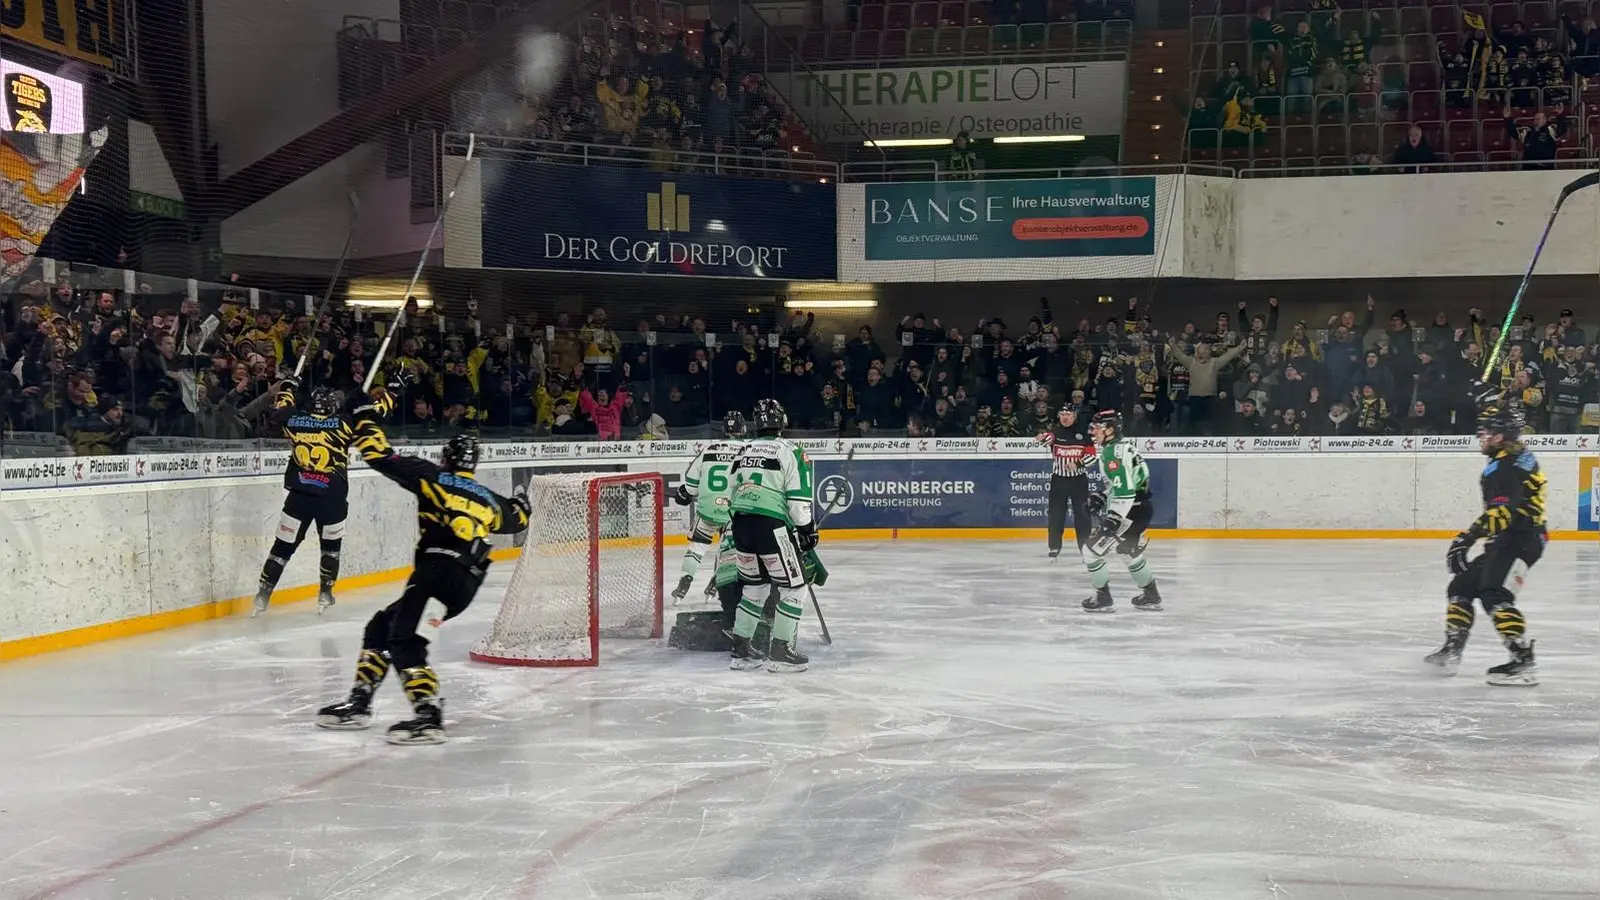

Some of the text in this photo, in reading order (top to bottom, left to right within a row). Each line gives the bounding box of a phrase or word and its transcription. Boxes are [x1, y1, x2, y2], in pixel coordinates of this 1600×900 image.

[11, 80, 46, 103] TIGERS
[796, 65, 1087, 107] THERAPIELOFT
[959, 111, 1083, 137] Osteopathie
[1012, 194, 1151, 209] Ihre Hausverwaltung
[870, 196, 1004, 224] BANSE
[896, 233, 979, 243] OBJEKTVERWALTUNG
[543, 233, 788, 268] DER GOLDREPORT
[586, 444, 632, 455] www.pio-24.de
[650, 441, 688, 451] Piotrowski
[851, 440, 910, 449] www.pio-24.de
[936, 439, 1227, 449] Piotrowski www.pio www.pio-24.de
[1253, 437, 1568, 448] Piotrowski www.pio-24.de Piotrowski pio-24.de
[1057, 448, 1082, 456] PENNY
[4, 463, 66, 482] www.pio-24.de
[90, 460, 130, 473] Piotrowski
[151, 456, 198, 473] www.pio-24.de
[217, 455, 248, 467] Piotrowski
[1010, 470, 1053, 479] Generala
[862, 479, 975, 495] NÜRNBERGER
[1010, 482, 1043, 491] Telefon
[862, 498, 942, 507] VERSICHERUNG
[1010, 496, 1049, 504] Generala
[1010, 508, 1042, 517] Telefon
